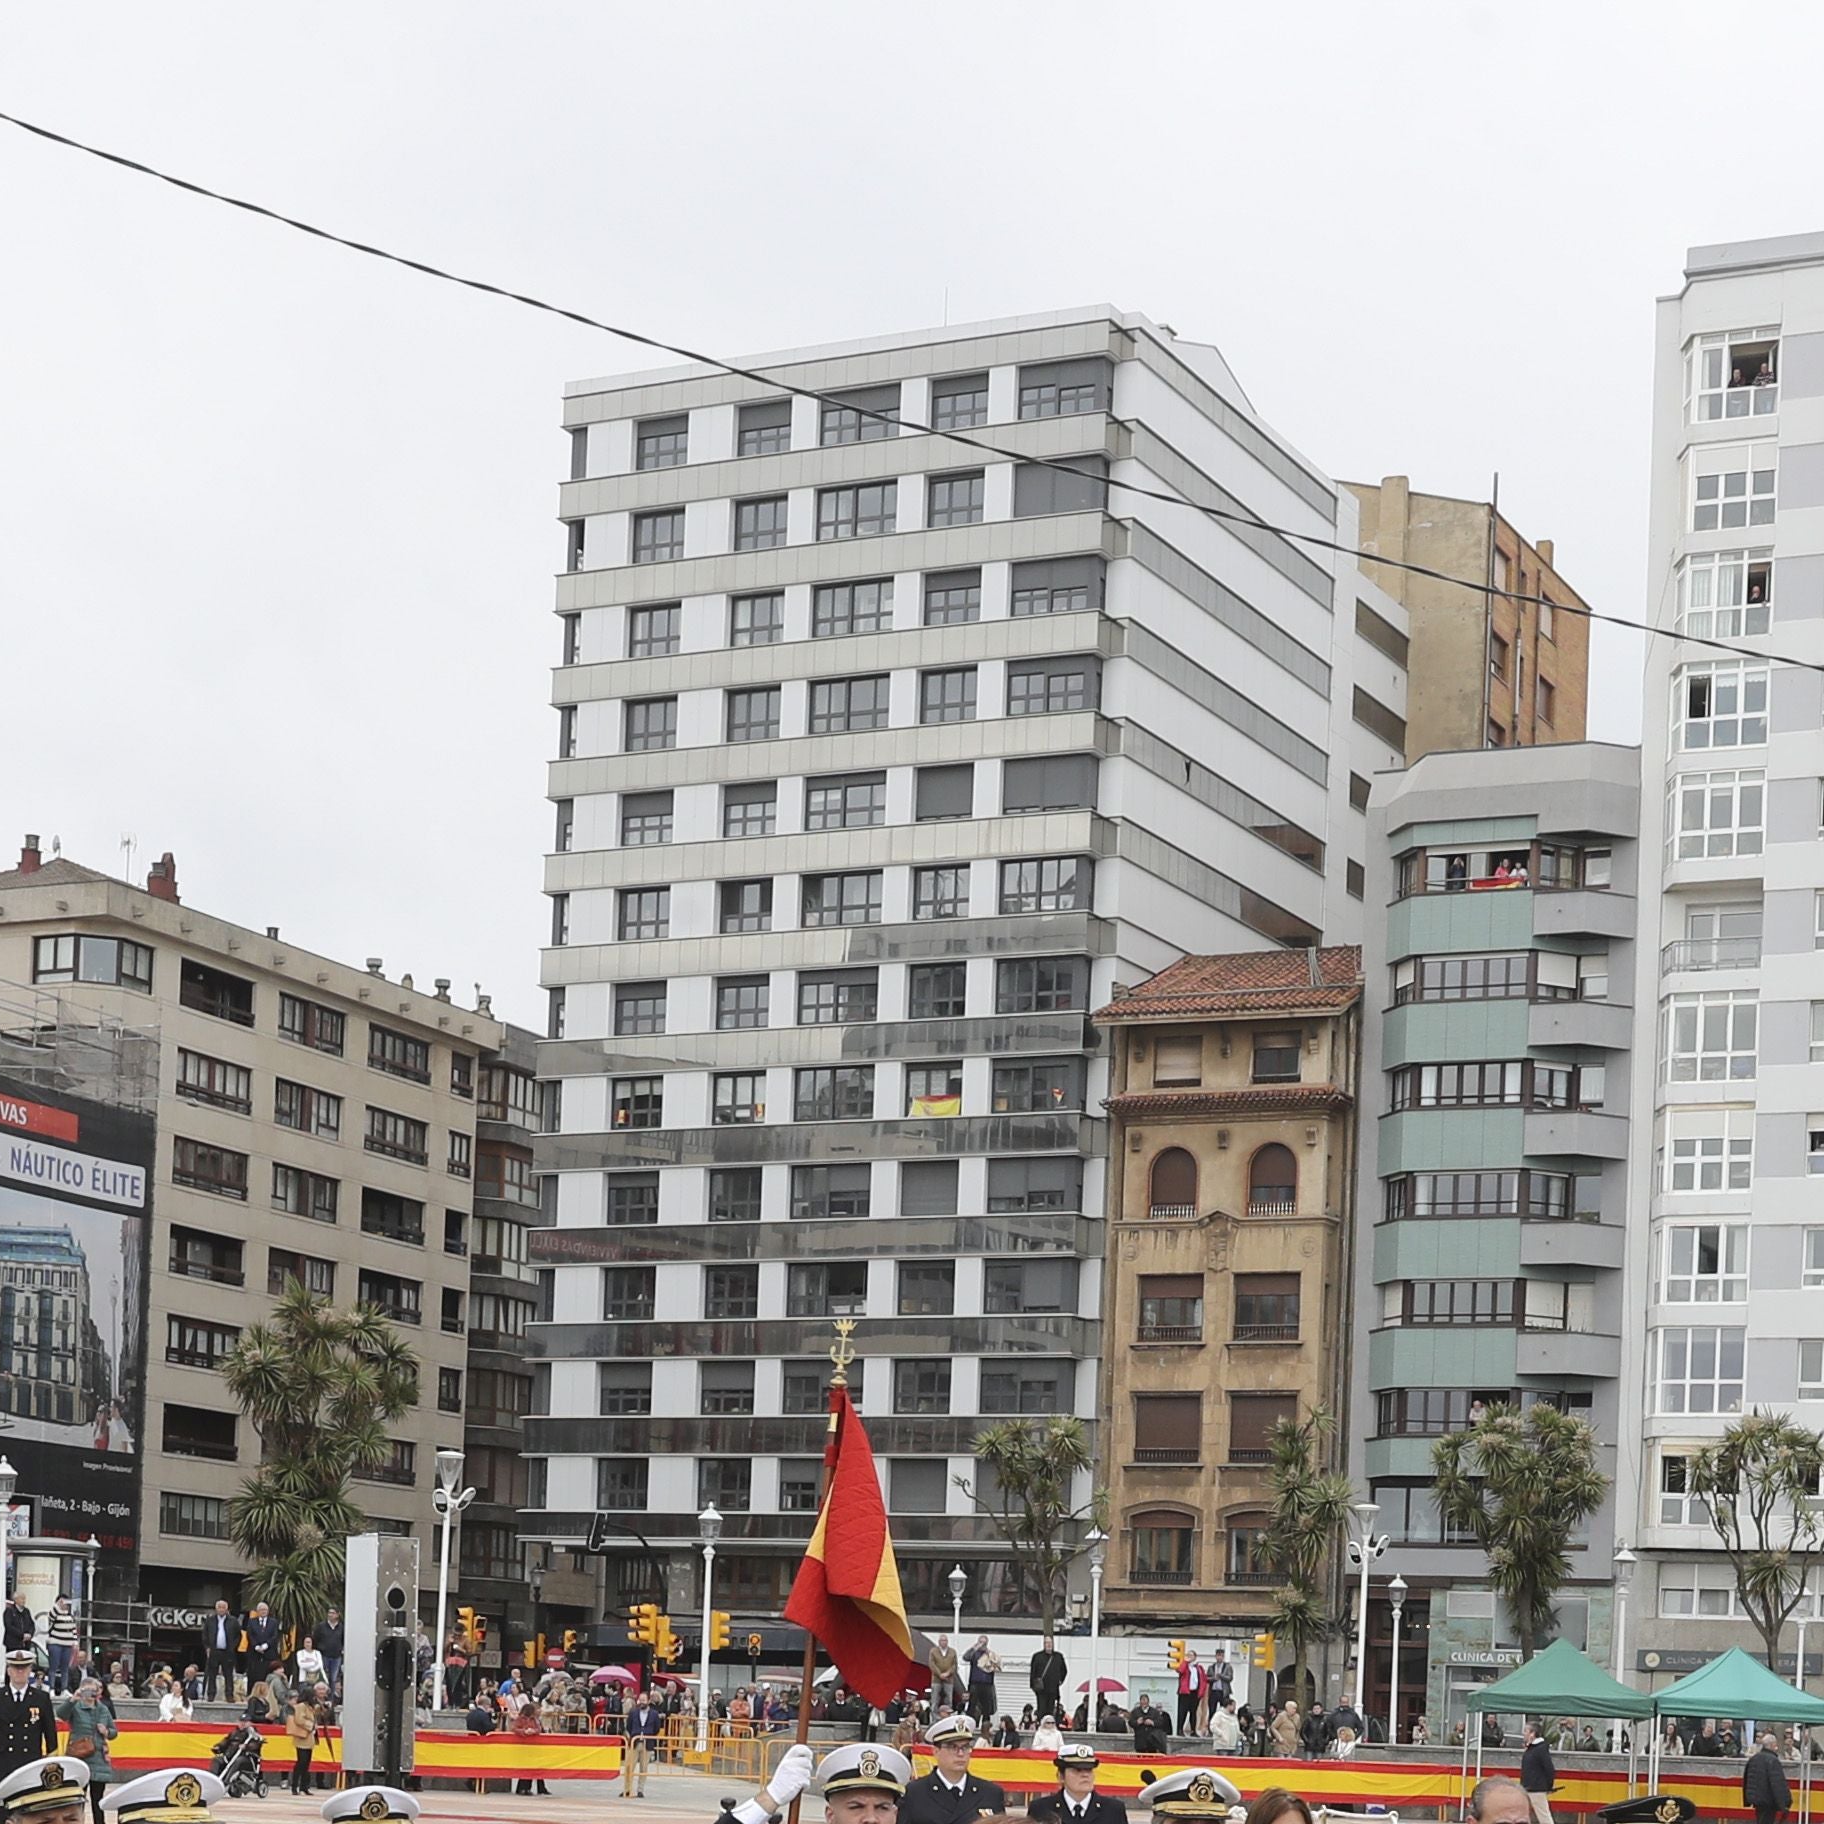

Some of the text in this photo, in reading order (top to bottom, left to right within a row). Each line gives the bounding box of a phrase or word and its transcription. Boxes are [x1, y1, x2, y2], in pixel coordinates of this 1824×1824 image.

[10, 1144, 141, 1201] NÁUTICO ÉLITE
[82, 1500, 101, 1515] Bajo
[107, 1503, 130, 1518] Gijón
